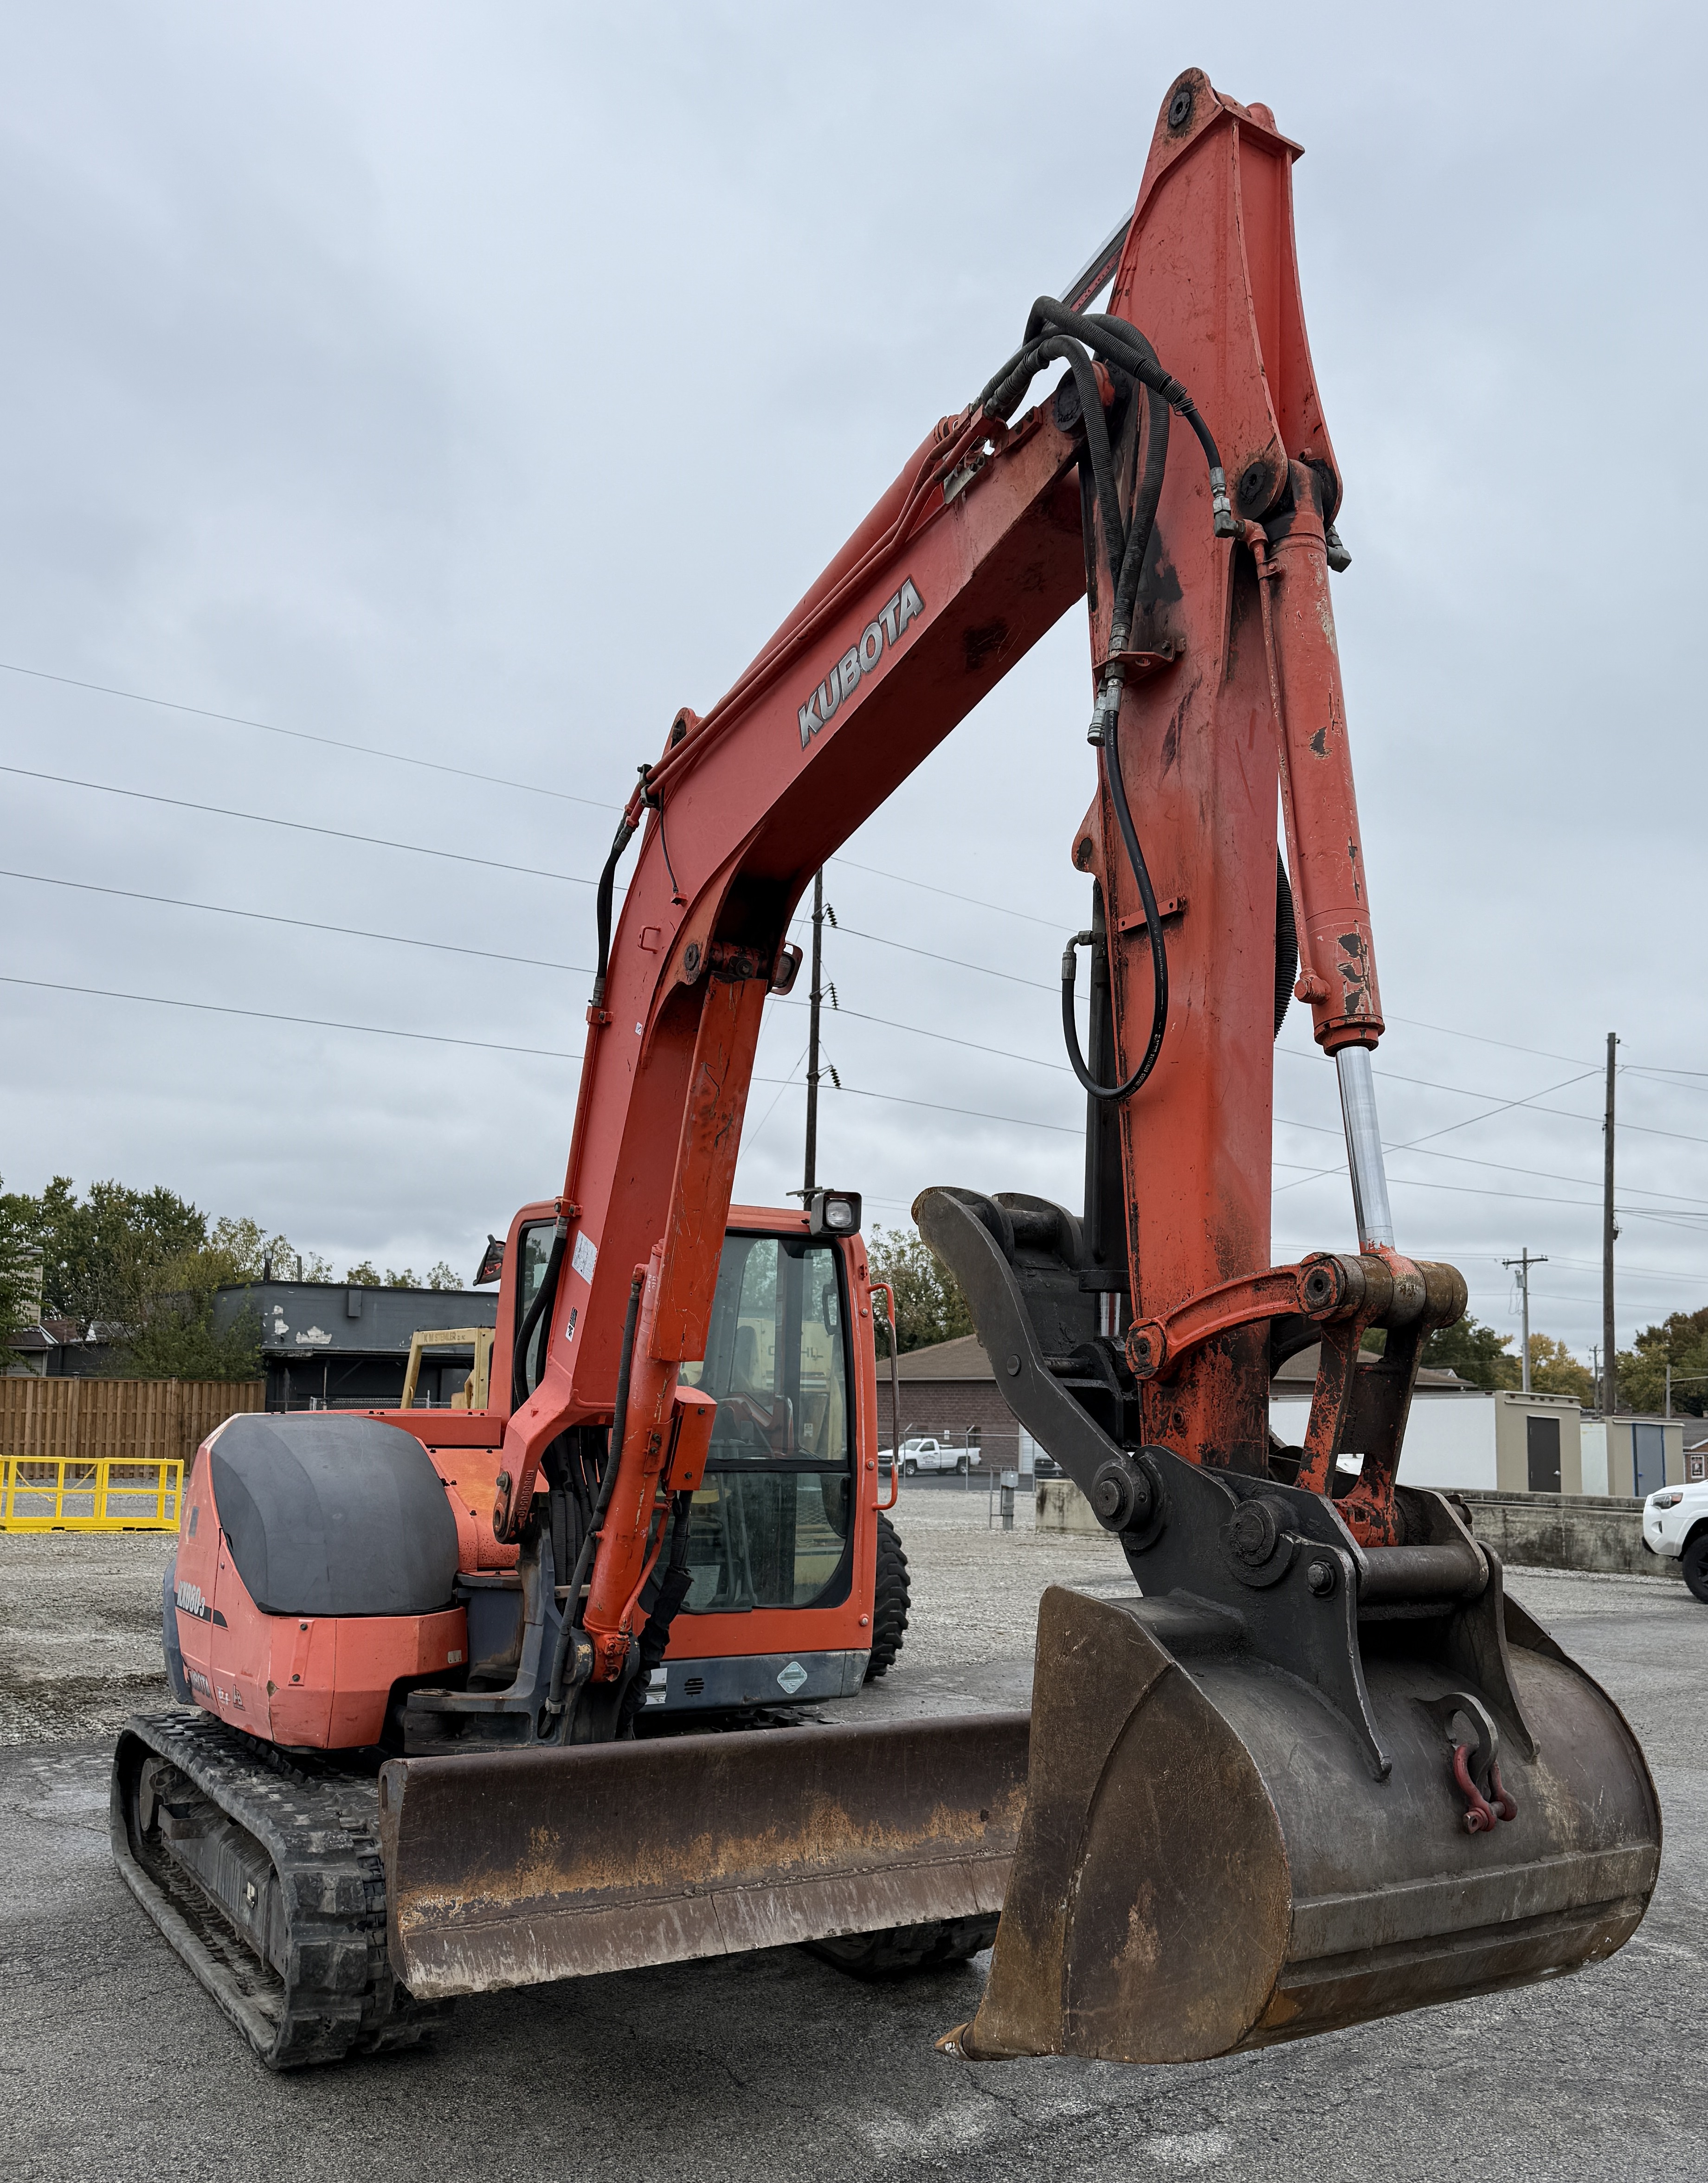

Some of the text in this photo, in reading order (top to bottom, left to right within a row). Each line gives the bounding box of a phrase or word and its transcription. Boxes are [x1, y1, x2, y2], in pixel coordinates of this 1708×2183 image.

[798, 575, 924, 749] KUBOTA
[424, 1333, 428, 1342] K
[429, 1333, 434, 1342] M
[177, 1580, 206, 1617] KX080-3
[188, 1669, 211, 1698] UBOTA
